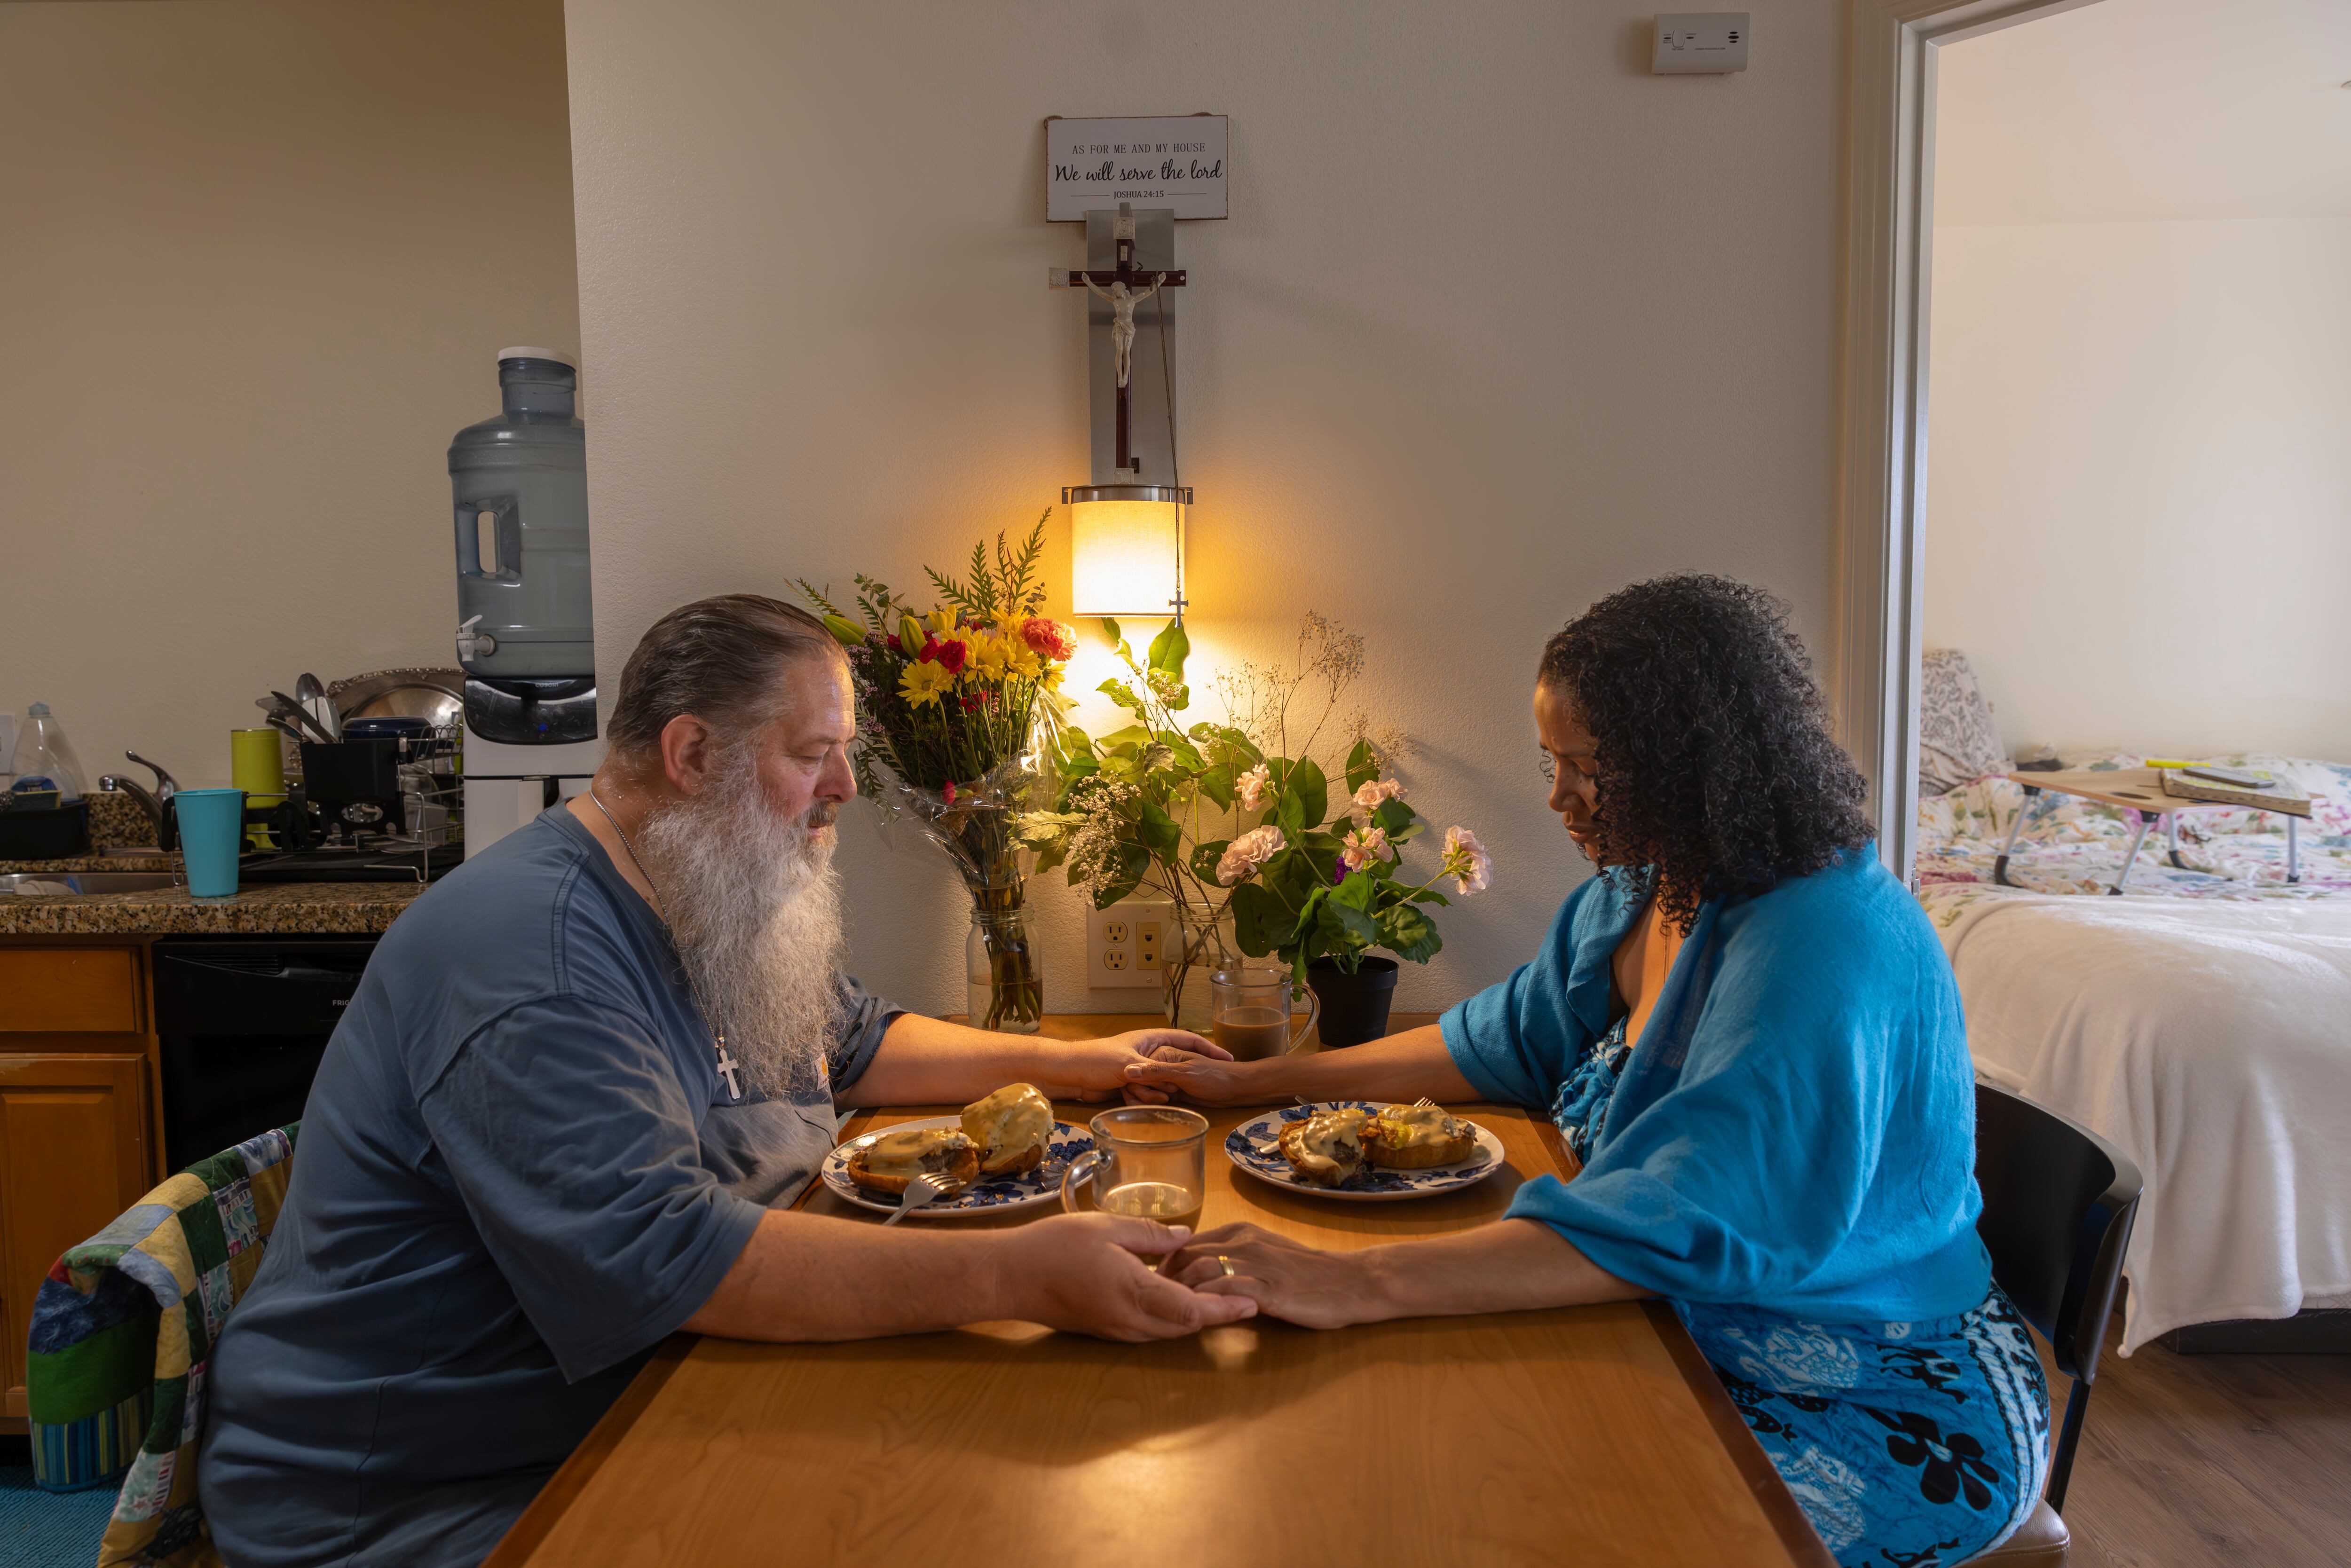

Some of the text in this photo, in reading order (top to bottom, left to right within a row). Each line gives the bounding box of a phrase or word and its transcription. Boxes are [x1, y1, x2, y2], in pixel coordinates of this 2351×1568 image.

[1073, 143, 1205, 154] AS FOR ME AND MY HOUSE
[1056, 159, 1222, 181] We will serve the lord
[1114, 191, 1142, 199] JOSHUA
